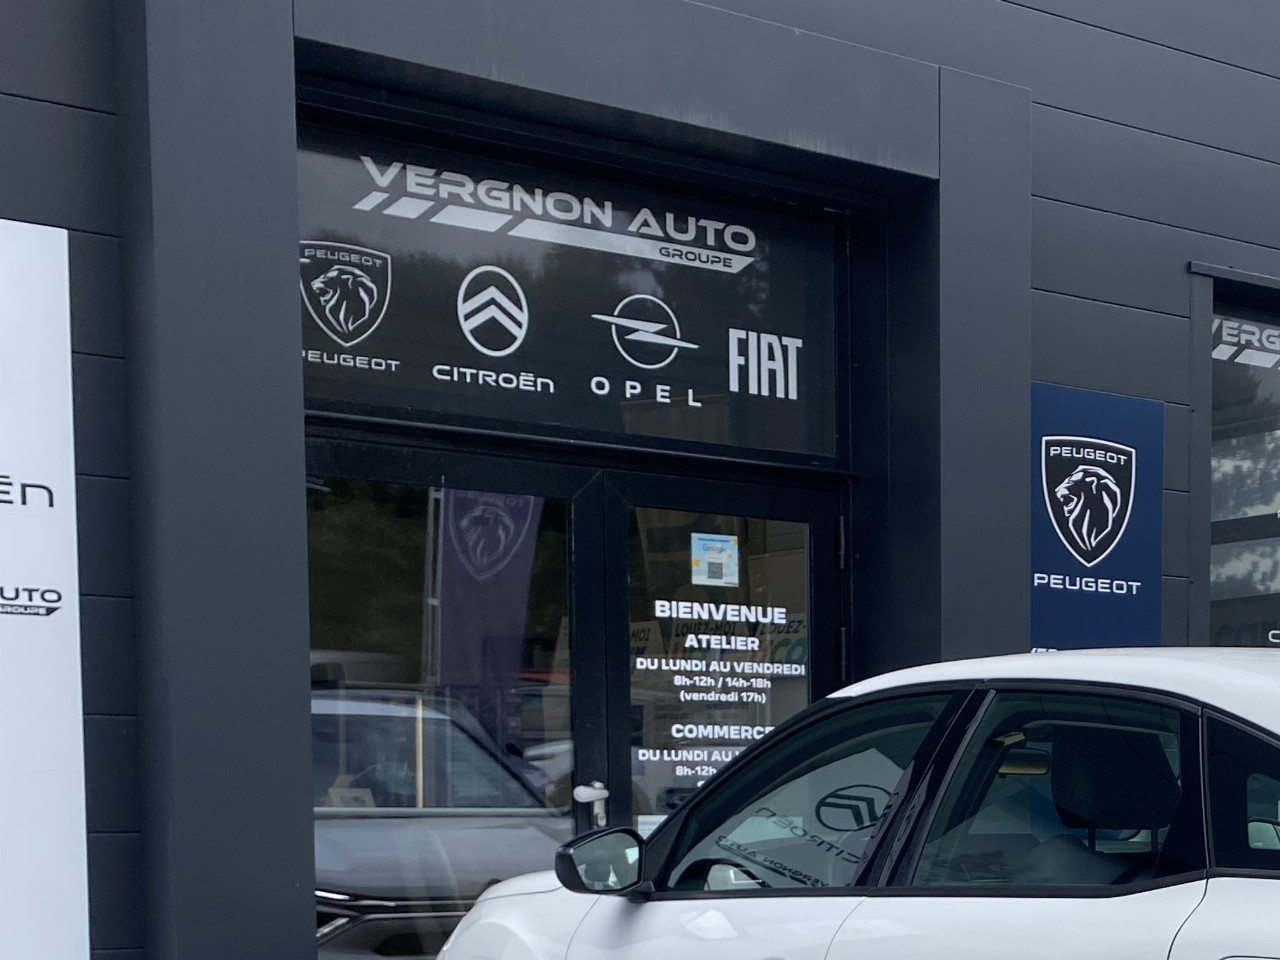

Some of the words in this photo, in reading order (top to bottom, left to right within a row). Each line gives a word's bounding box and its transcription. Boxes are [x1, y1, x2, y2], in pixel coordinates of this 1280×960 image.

[360, 156, 612, 227] VERGNON
[627, 207, 756, 252] AUTO
[304, 248, 383, 268] PEUGEOT
[658, 246, 733, 268] GROUPE
[729, 328, 803, 400] FIAT
[1050, 446, 1128, 466] PEUGEOT
[1034, 573, 1141, 595] PEUGEOT
[655, 600, 786, 624] BIENVENUE
[684, 634, 759, 650] ATELIER
[636, 657, 659, 670] DU
[661, 658, 706, 671] LUNDI
[709, 660, 731, 673] AU
[733, 661, 806, 676] VENDREDI
[673, 675, 715, 687] 8h-12h
[725, 677, 772, 689] 14h-18h
[679, 690, 739, 703] (vendredi
[740, 691, 767, 704] 17h)
[638, 749, 662, 761] DU
[663, 750, 708, 762] LUNDI
[711, 751, 733, 762] AU
